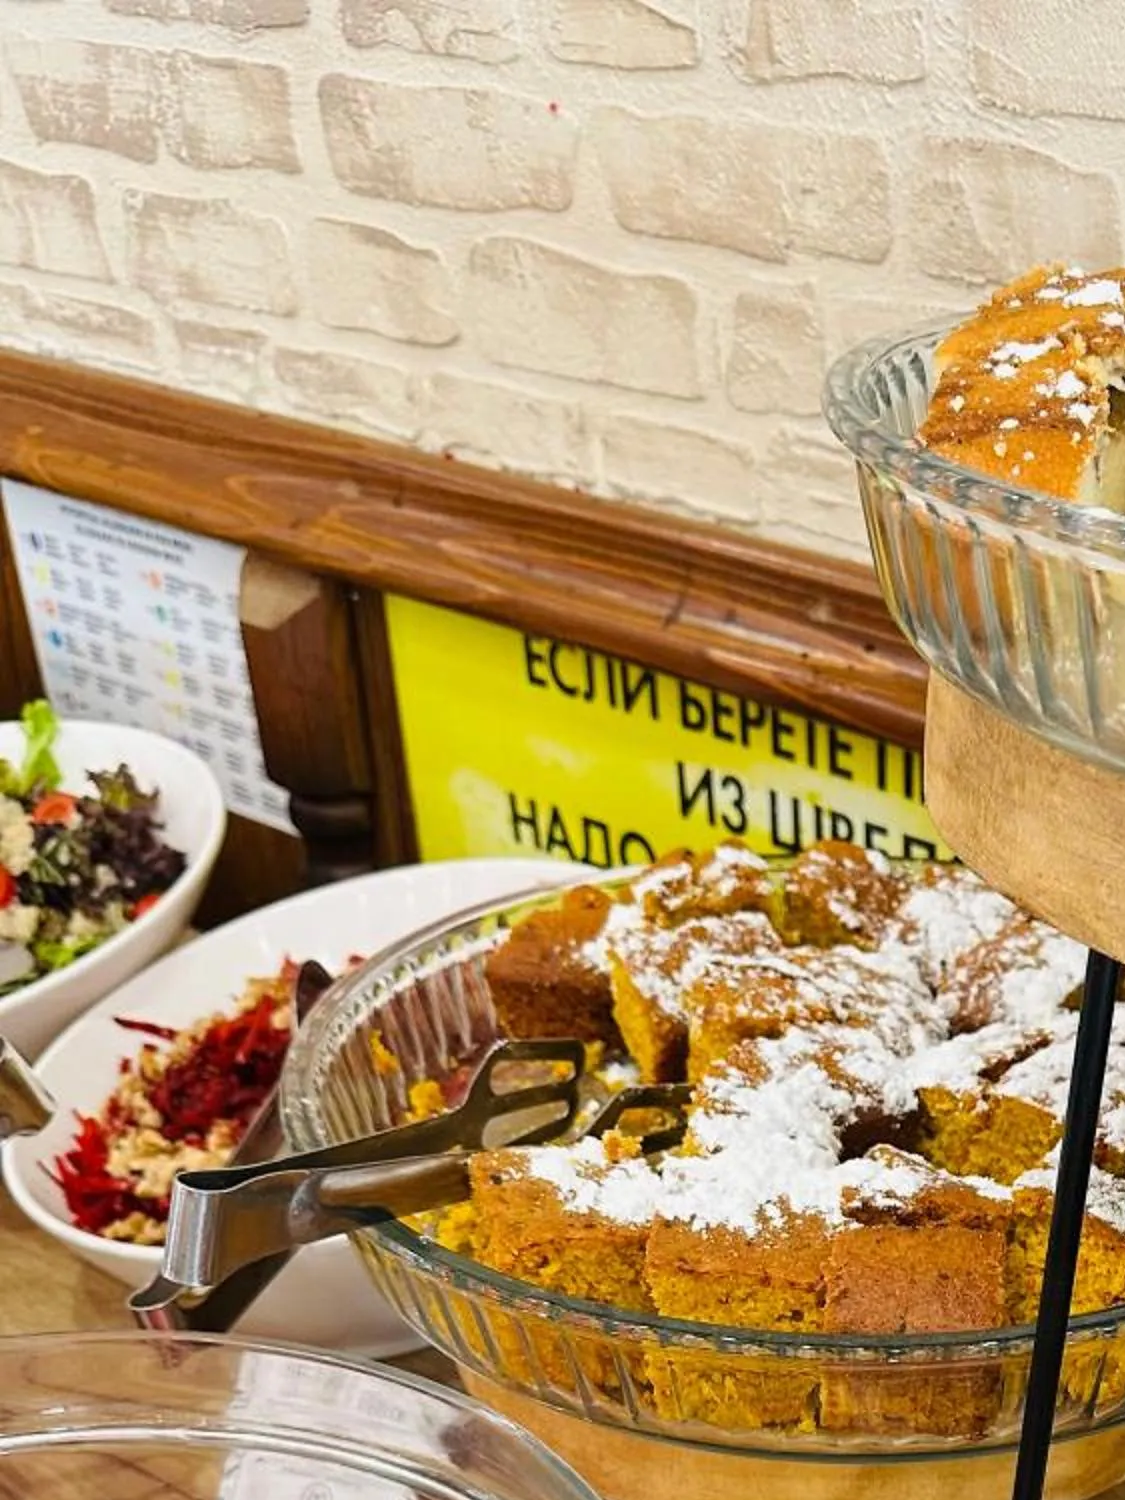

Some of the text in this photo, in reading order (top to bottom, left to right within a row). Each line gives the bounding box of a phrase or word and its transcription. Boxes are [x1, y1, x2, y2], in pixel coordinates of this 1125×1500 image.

[523, 634, 660, 721] ЕСЛИ
[678, 680, 854, 780] БЕРЕТЕ
[507, 791, 658, 869] НАДО
[677, 760, 749, 836] ИЗ
